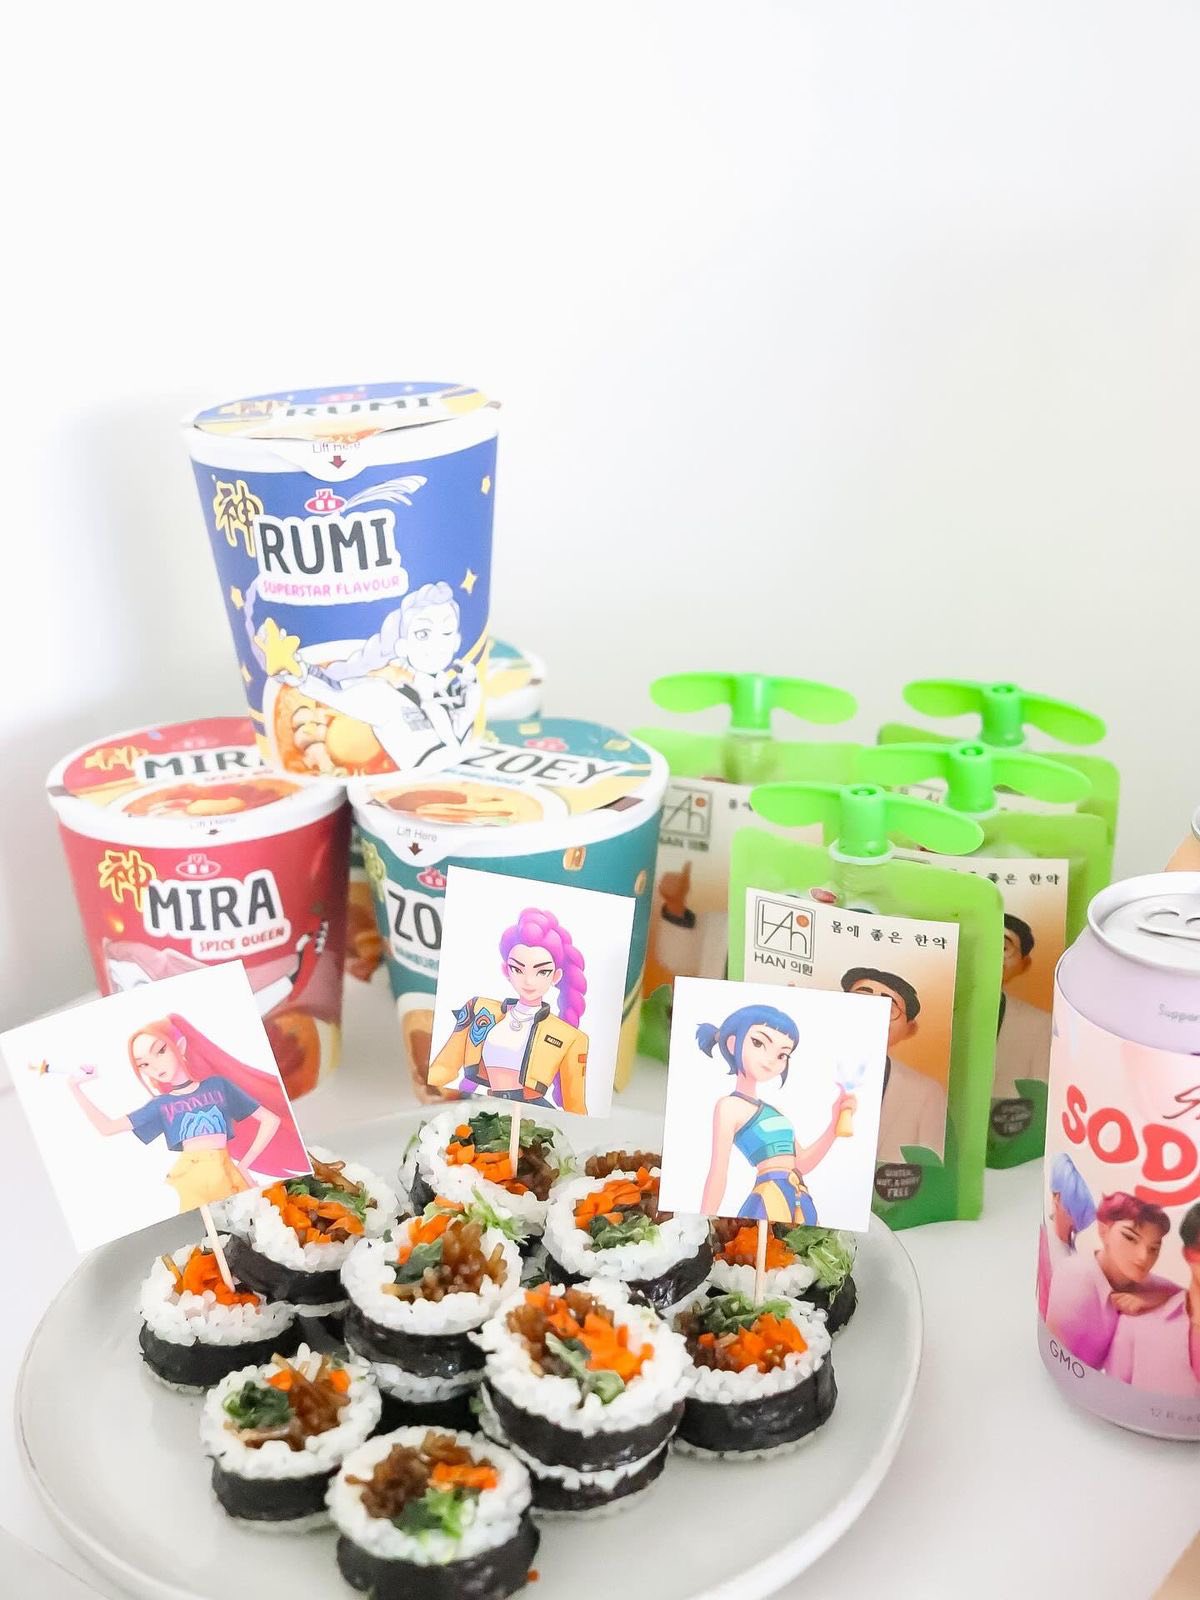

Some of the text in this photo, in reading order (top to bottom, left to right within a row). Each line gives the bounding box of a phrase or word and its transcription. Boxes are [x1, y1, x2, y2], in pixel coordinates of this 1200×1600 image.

[286, 396, 429, 417] RUMI
[258, 517, 393, 576] RUMI
[263, 575, 401, 598] SUPERSTAR FLAVOUR
[144, 751, 265, 779] MIR
[460, 745, 622, 785] ZOEY
[148, 877, 277, 932] MIRA
[387, 888, 443, 951] ZO
[199, 926, 286, 953] SPICE QUEEN
[830, 919, 949, 950] 몸에 좋은 한약
[754, 951, 814, 977] HAN 의원
[1061, 1083, 1199, 1183] SOD
[1049, 1339, 1086, 1379] GMO
